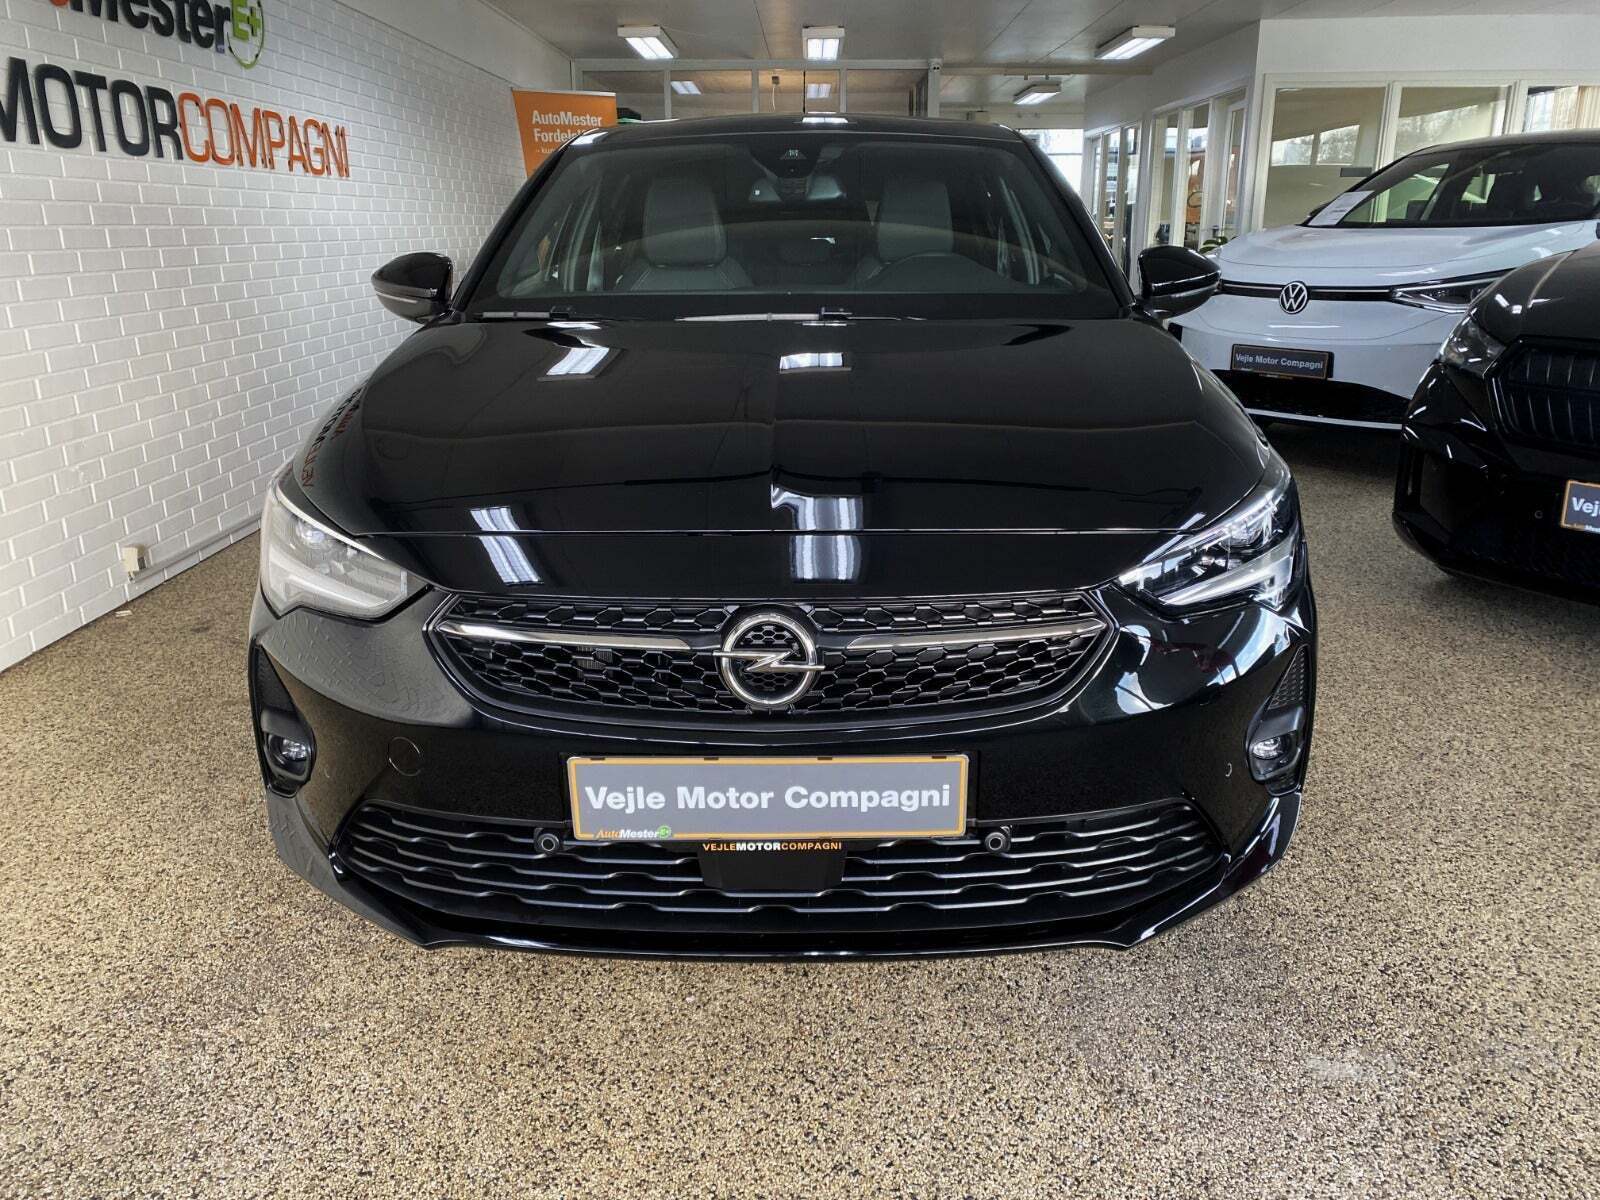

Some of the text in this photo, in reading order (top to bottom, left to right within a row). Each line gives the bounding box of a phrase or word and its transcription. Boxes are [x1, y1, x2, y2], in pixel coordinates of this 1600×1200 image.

[532, 110, 602, 127] AutoMester
[1235, 353, 1324, 370] Vejle Motor Compagni
[1572, 496, 1600, 517] Vej
[585, 784, 951, 814] Vejle Motor Compagni
